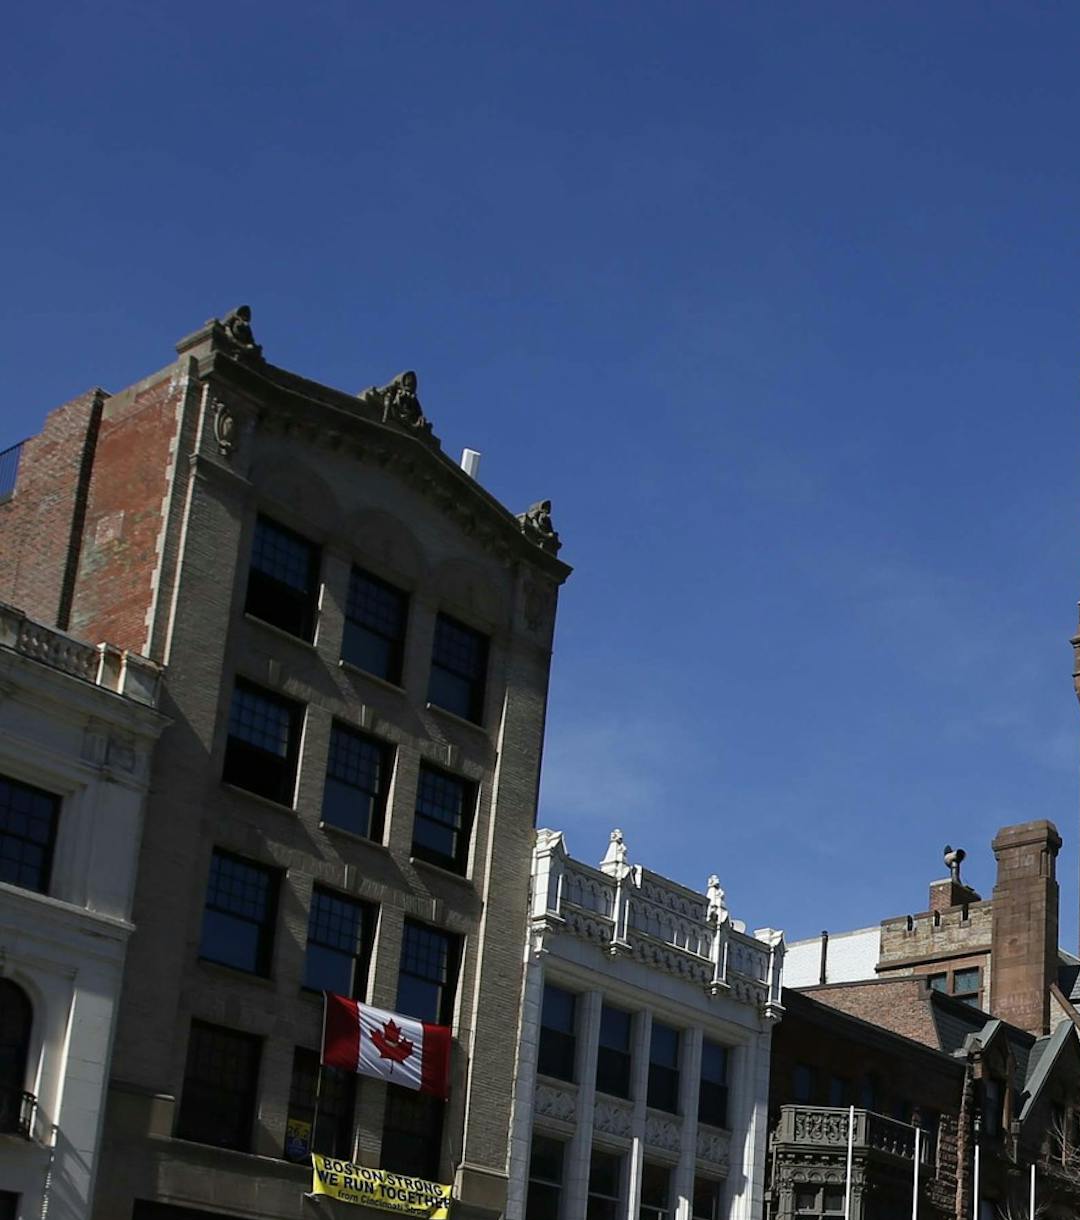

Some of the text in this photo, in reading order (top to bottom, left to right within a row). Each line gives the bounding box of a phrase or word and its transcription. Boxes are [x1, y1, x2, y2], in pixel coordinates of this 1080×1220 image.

[319, 1170, 338, 1186] WE
[344, 1176, 374, 1194] RUN
[323, 1159, 443, 1197] BOSTON STRONG
[338, 1189, 358, 1202] from
[361, 1195, 402, 1211] Cincinnati
